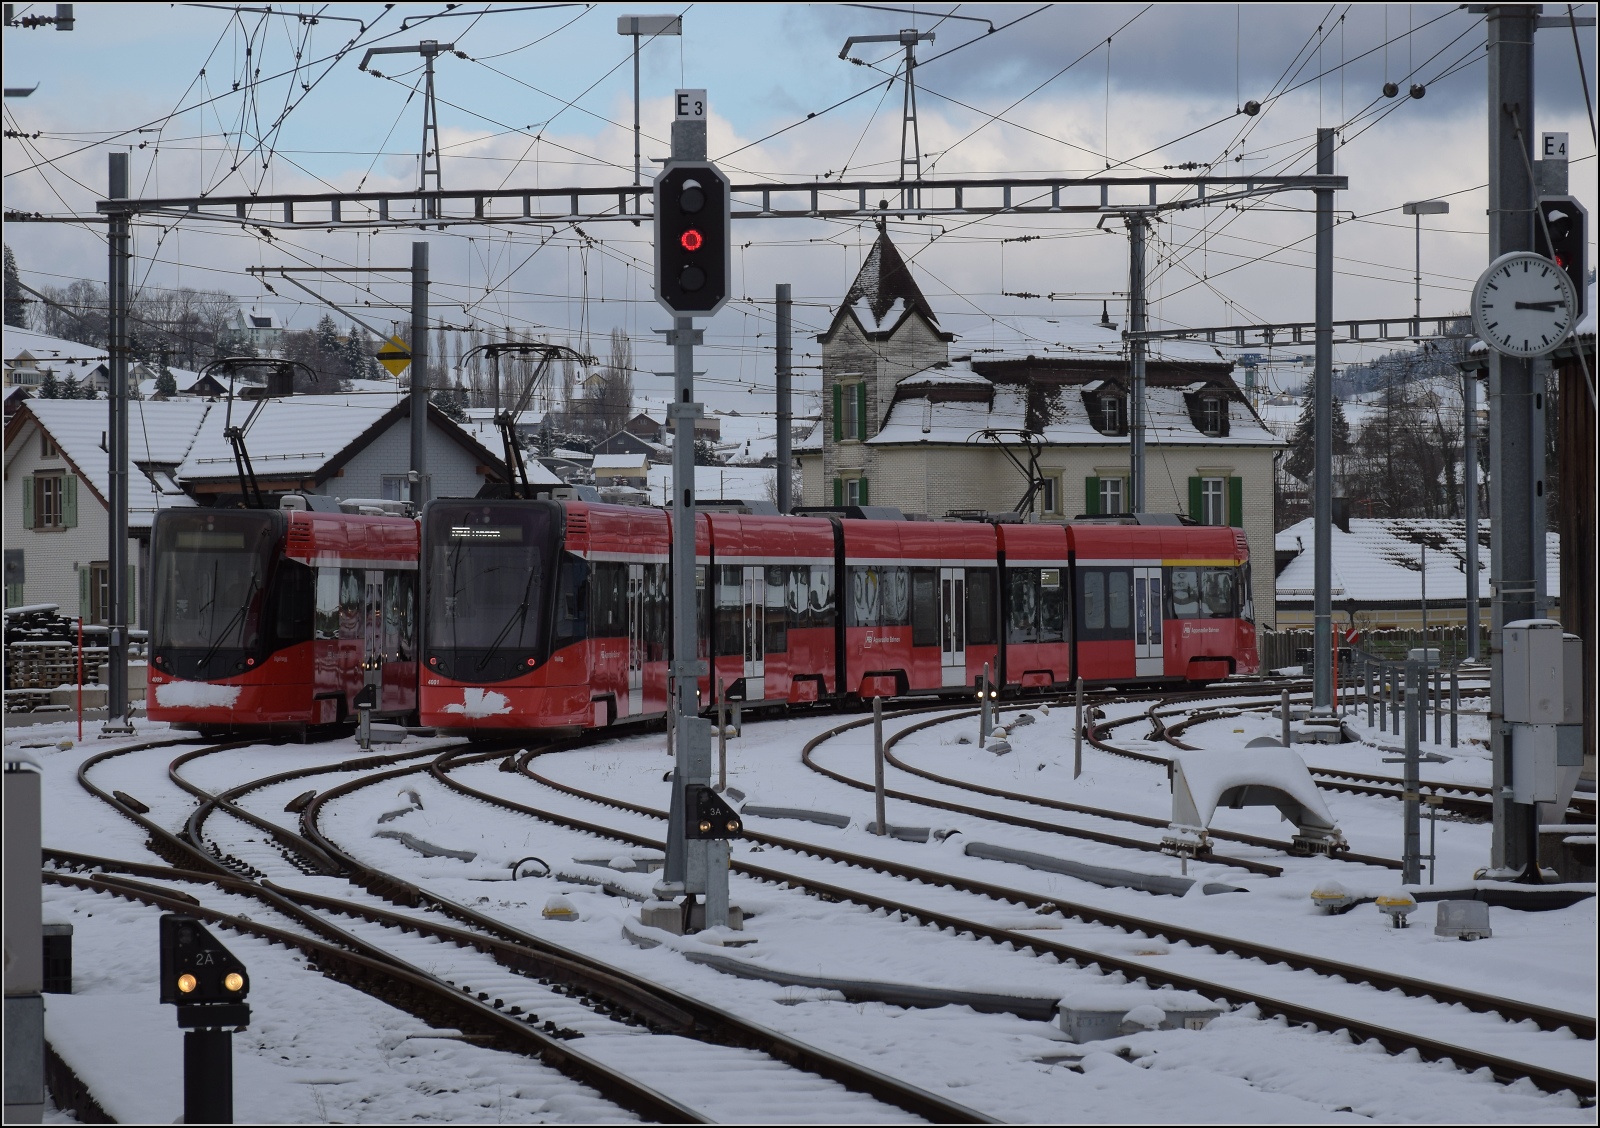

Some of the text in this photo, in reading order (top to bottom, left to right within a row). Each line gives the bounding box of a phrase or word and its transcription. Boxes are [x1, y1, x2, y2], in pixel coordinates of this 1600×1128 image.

[710, 807, 722, 816] 3A
[195, 953, 214, 966] 2A
[1192, 1021, 1204, 1031] 17
